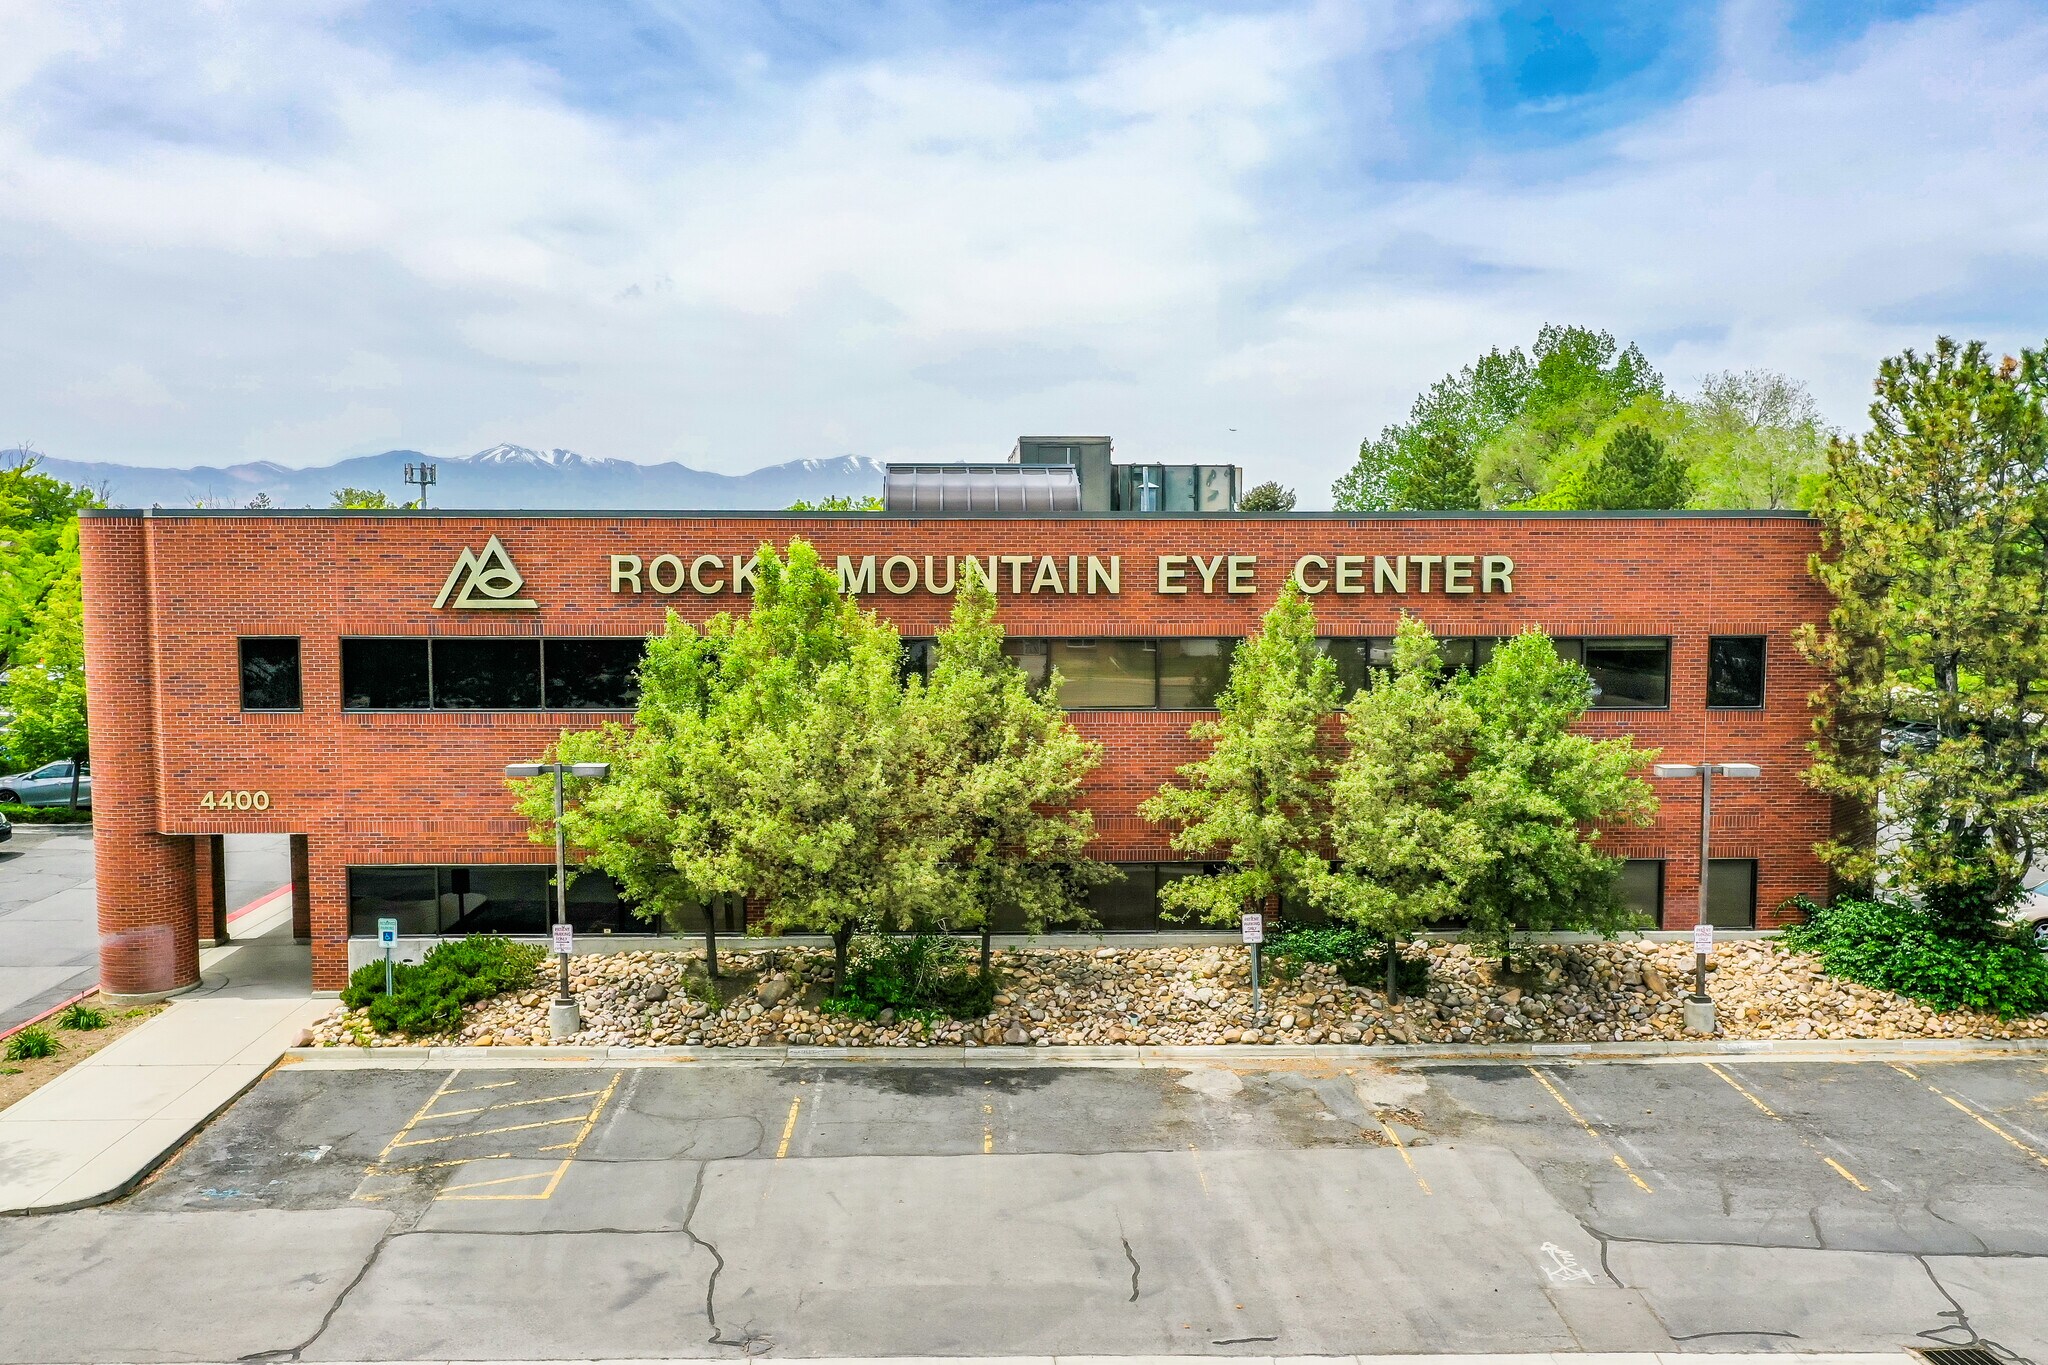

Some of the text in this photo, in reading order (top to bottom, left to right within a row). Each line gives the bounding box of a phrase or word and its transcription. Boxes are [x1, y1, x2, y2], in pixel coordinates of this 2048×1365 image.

[610, 553, 1515, 595] ROCK MOUNTAIN EYE CENTER
[200, 790, 270, 811] 4400
